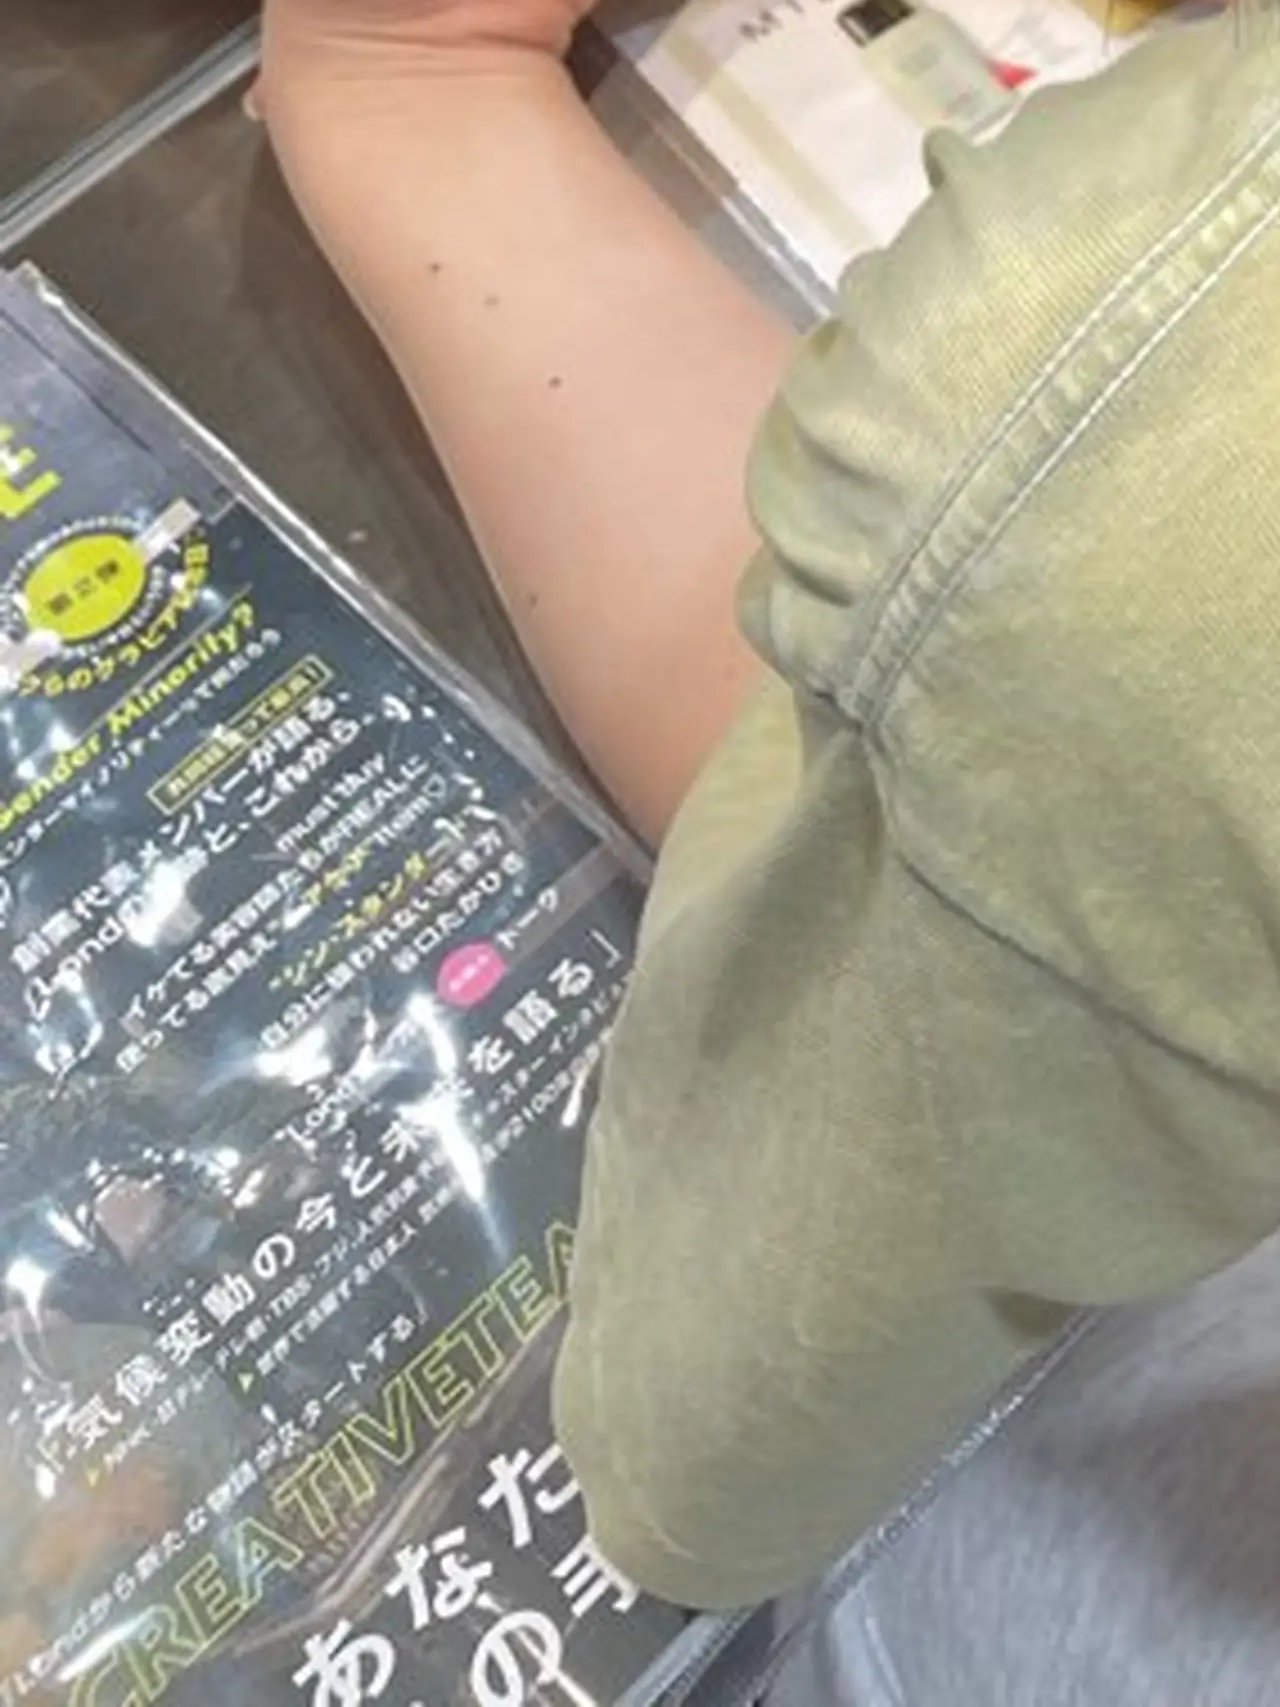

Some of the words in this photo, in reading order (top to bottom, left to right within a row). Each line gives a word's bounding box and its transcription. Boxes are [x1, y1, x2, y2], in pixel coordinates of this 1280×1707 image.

[108, 599, 257, 735] Minority?
[293, 1446, 580, 1707] あなた
